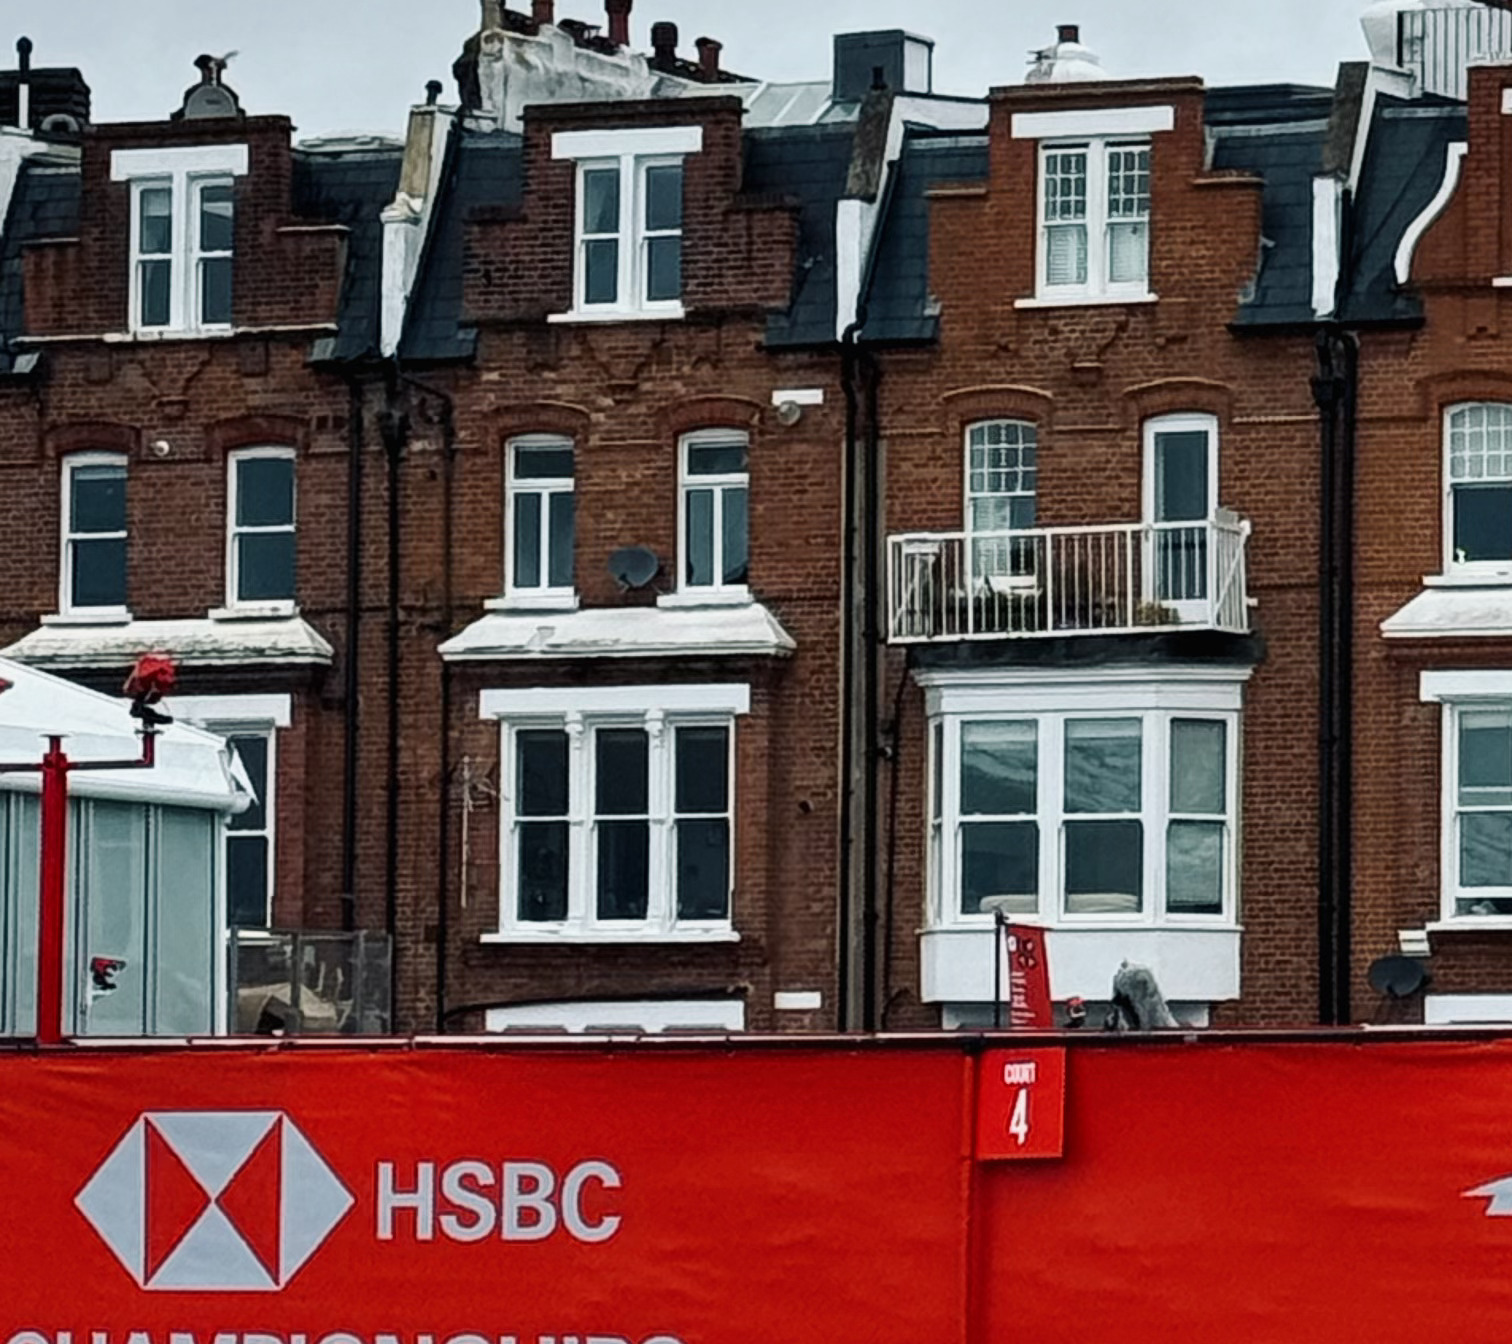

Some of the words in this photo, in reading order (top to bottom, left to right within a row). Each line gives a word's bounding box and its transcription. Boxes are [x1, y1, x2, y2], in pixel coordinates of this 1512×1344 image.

[1004, 1062, 1036, 1084] COURT
[1009, 1088, 1029, 1145] 4
[375, 1160, 621, 1243] HSBC
